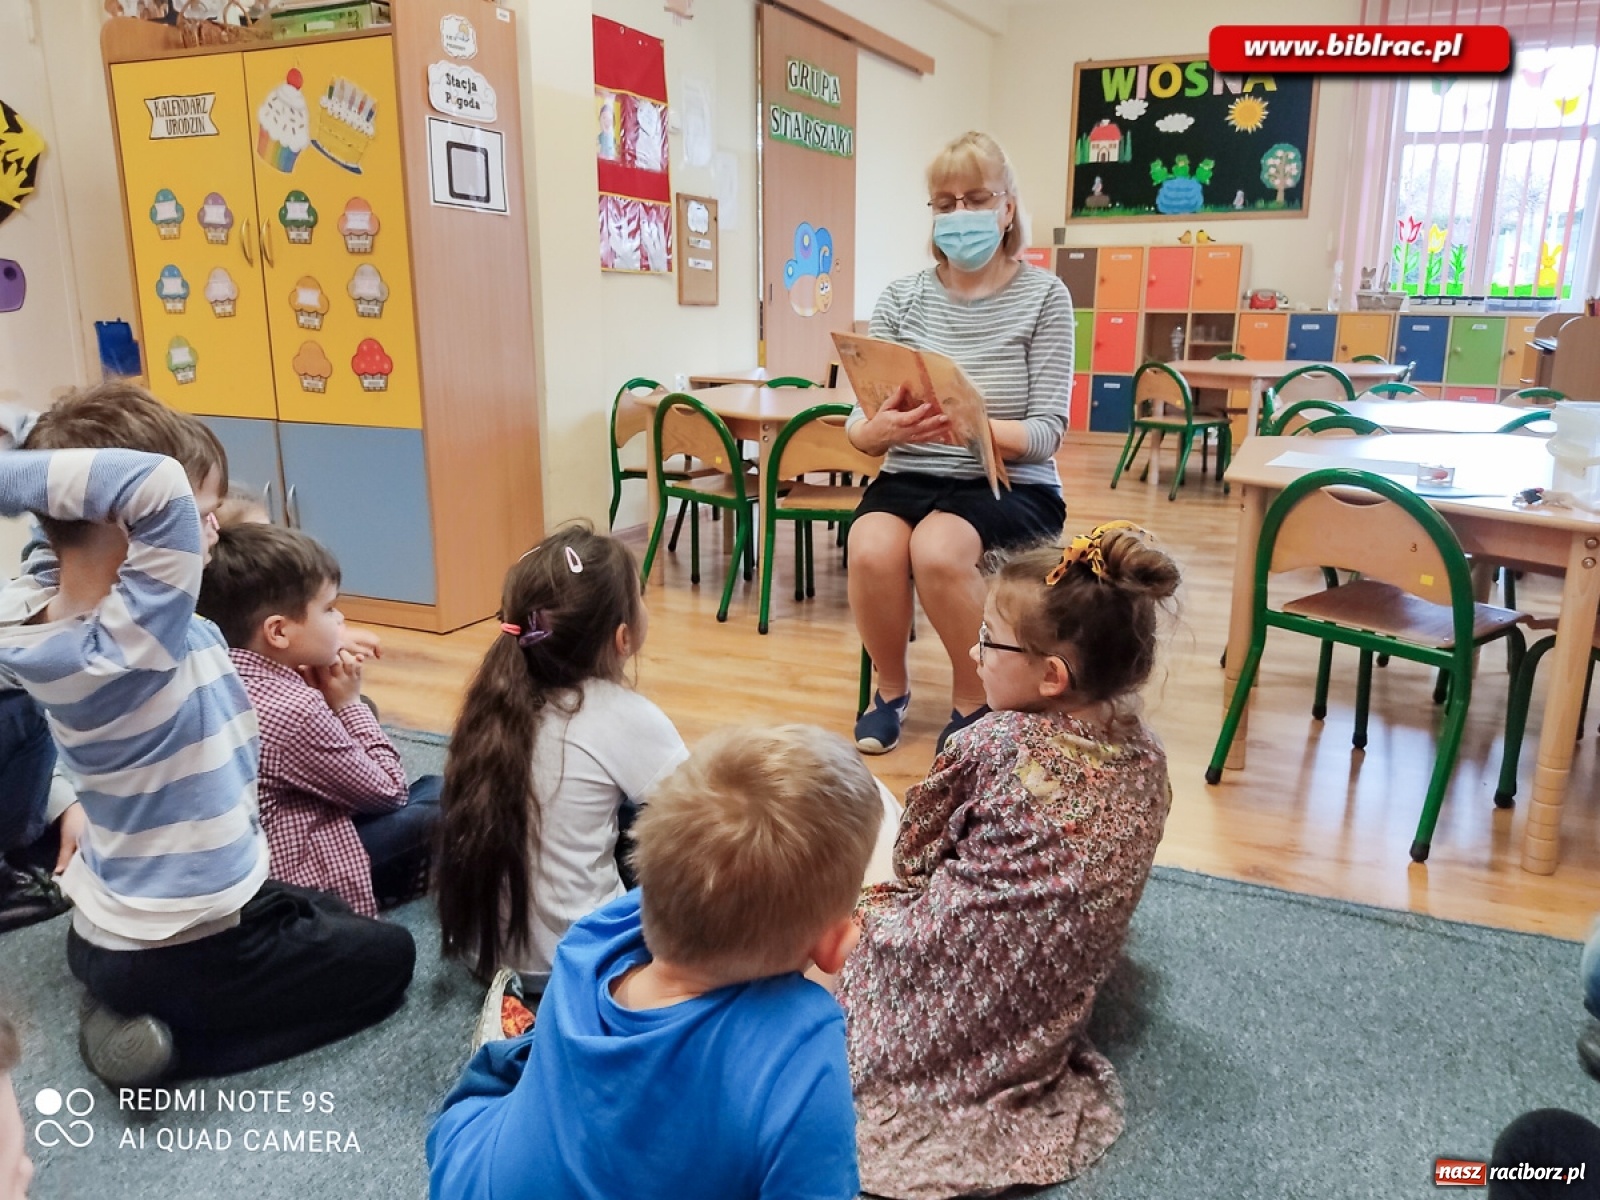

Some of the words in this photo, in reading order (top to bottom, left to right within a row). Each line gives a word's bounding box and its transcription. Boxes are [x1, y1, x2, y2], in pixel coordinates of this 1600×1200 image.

[444, 72, 478, 95] Stacja
[788, 62, 840, 101] GRUPA
[154, 96, 208, 118] KALENDARZ
[165, 115, 206, 136] URODZIN
[771, 107, 852, 155] STARSZAKI
